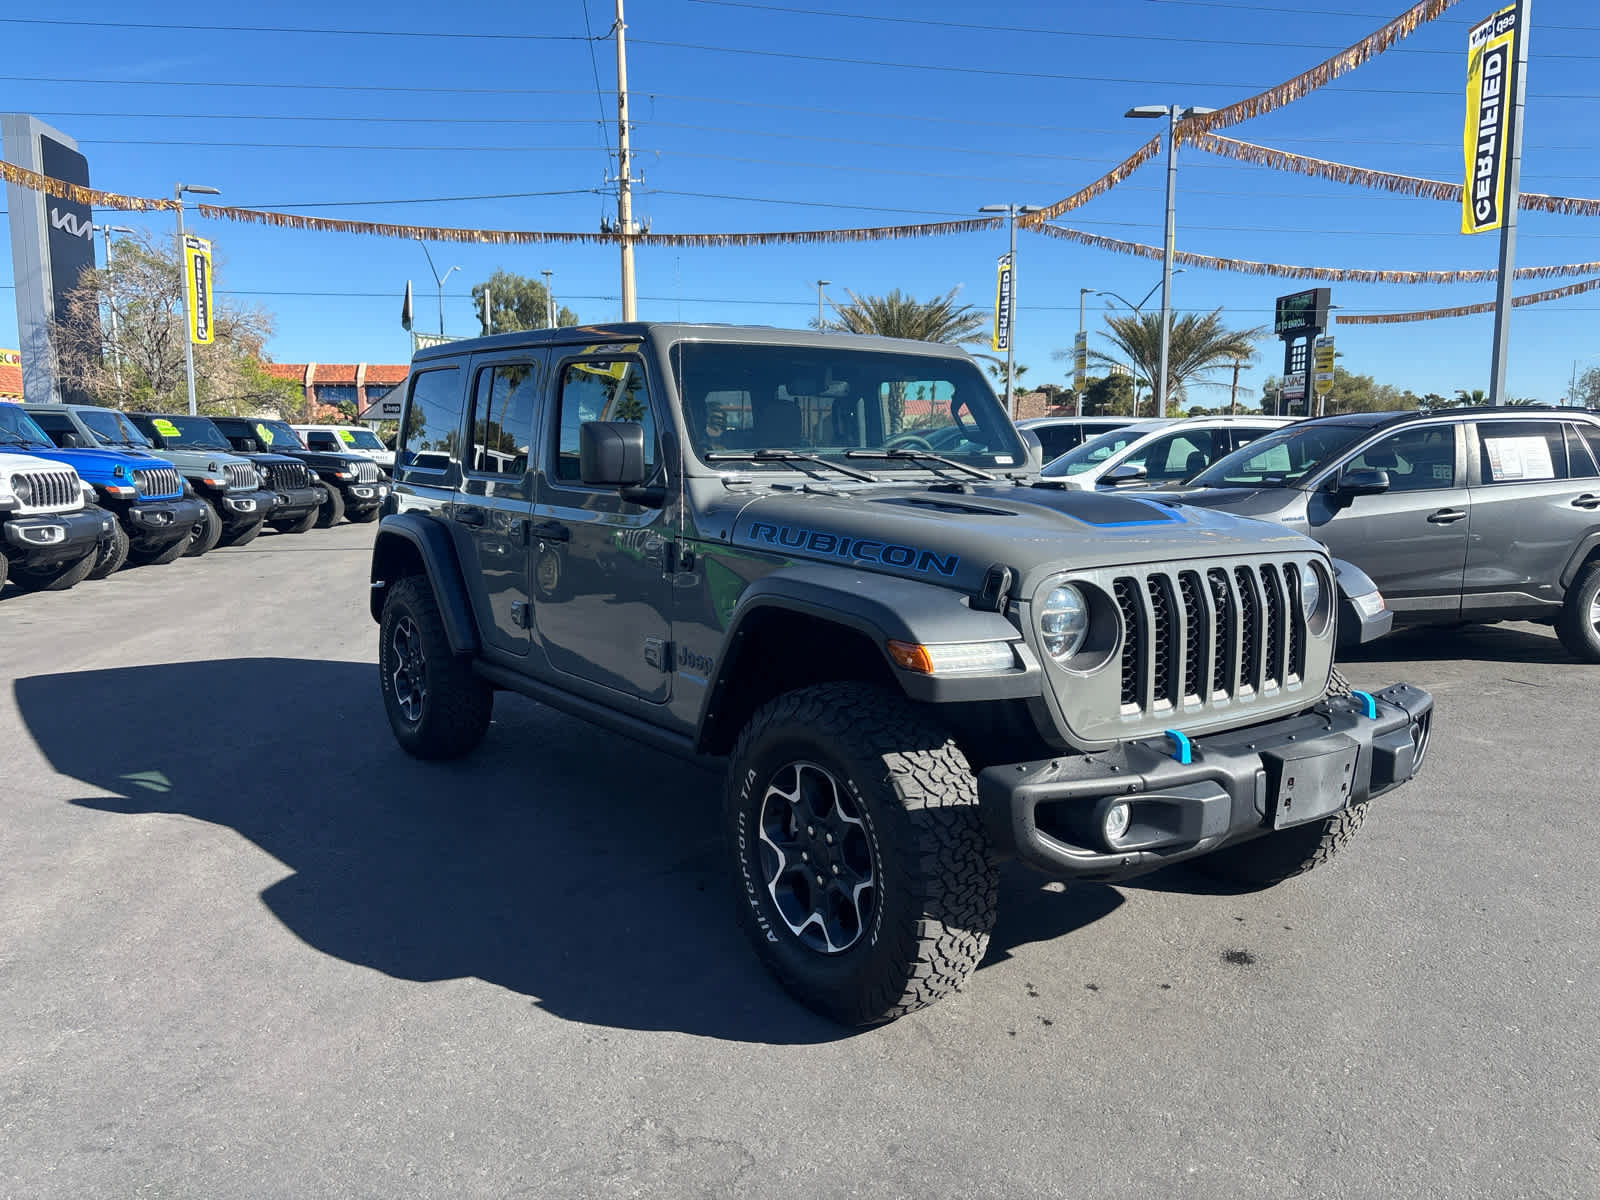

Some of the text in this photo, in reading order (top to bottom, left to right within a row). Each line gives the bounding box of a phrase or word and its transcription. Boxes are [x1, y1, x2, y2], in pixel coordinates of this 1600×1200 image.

[51, 207, 93, 241] KIA
[195, 257, 207, 340] CERTIFIED
[383, 404, 400, 414] Jeep
[748, 520, 961, 577] RUBICON
[679, 646, 714, 677] Jeep
[740, 768, 758, 800] T/A
